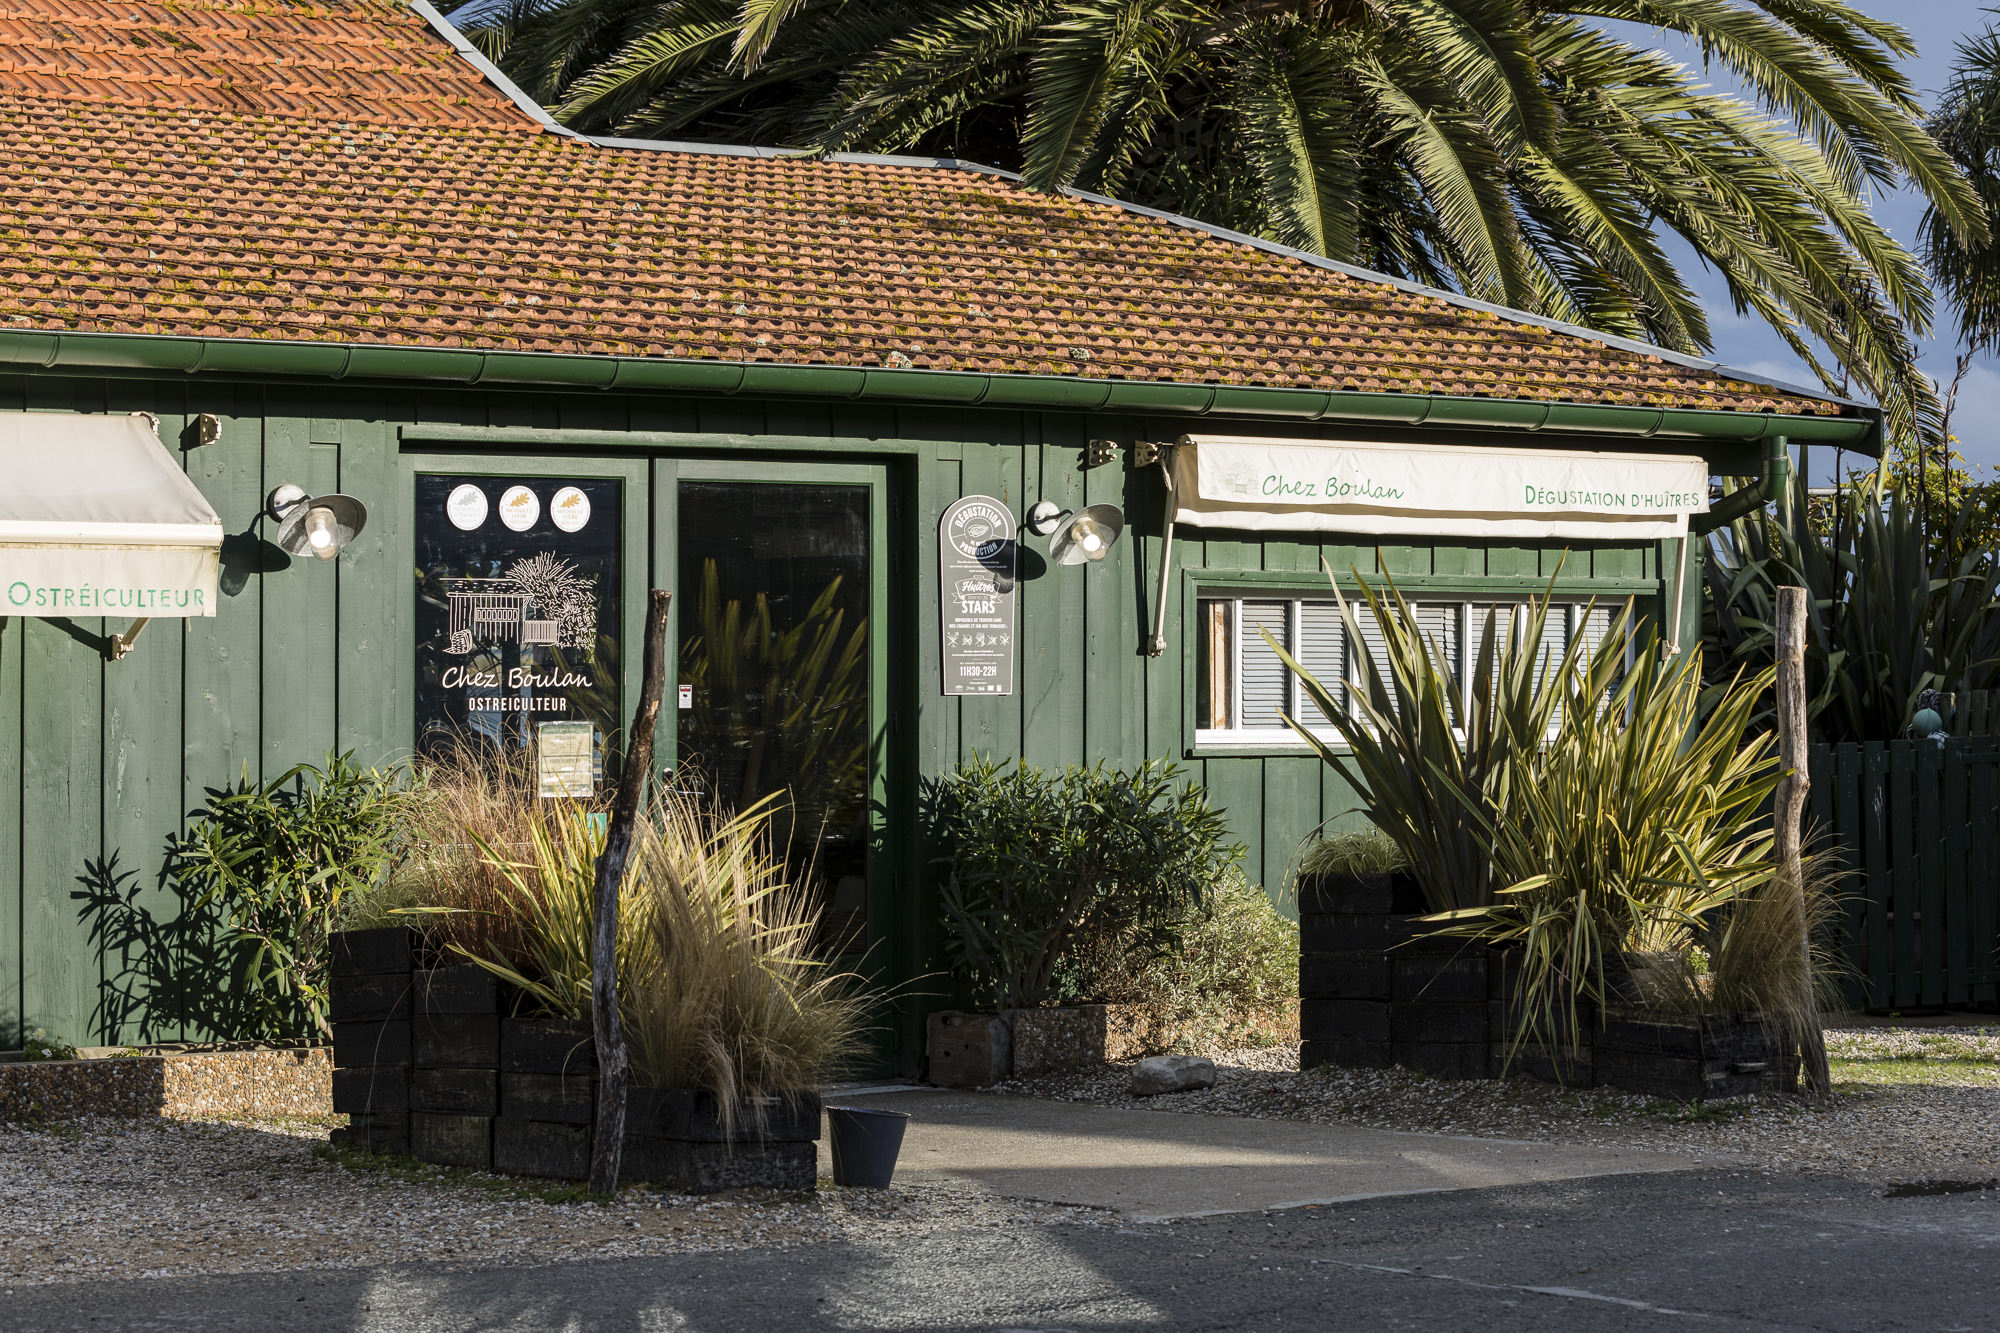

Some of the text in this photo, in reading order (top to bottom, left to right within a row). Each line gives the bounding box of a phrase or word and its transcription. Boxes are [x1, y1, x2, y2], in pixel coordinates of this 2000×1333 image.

[1262, 475, 1404, 499] Chez Boulan
[1525, 485, 1625, 507] DÉGUSTATION
[955, 506, 1002, 528] DÉGUSTATION
[959, 541, 998, 556] PRODUCTION
[961, 600, 996, 614] STARS
[442, 665, 593, 689] Chez Boulan
[960, 665, 997, 677] 11H30-22H
[468, 697, 567, 712] OSTREICULTEUR
